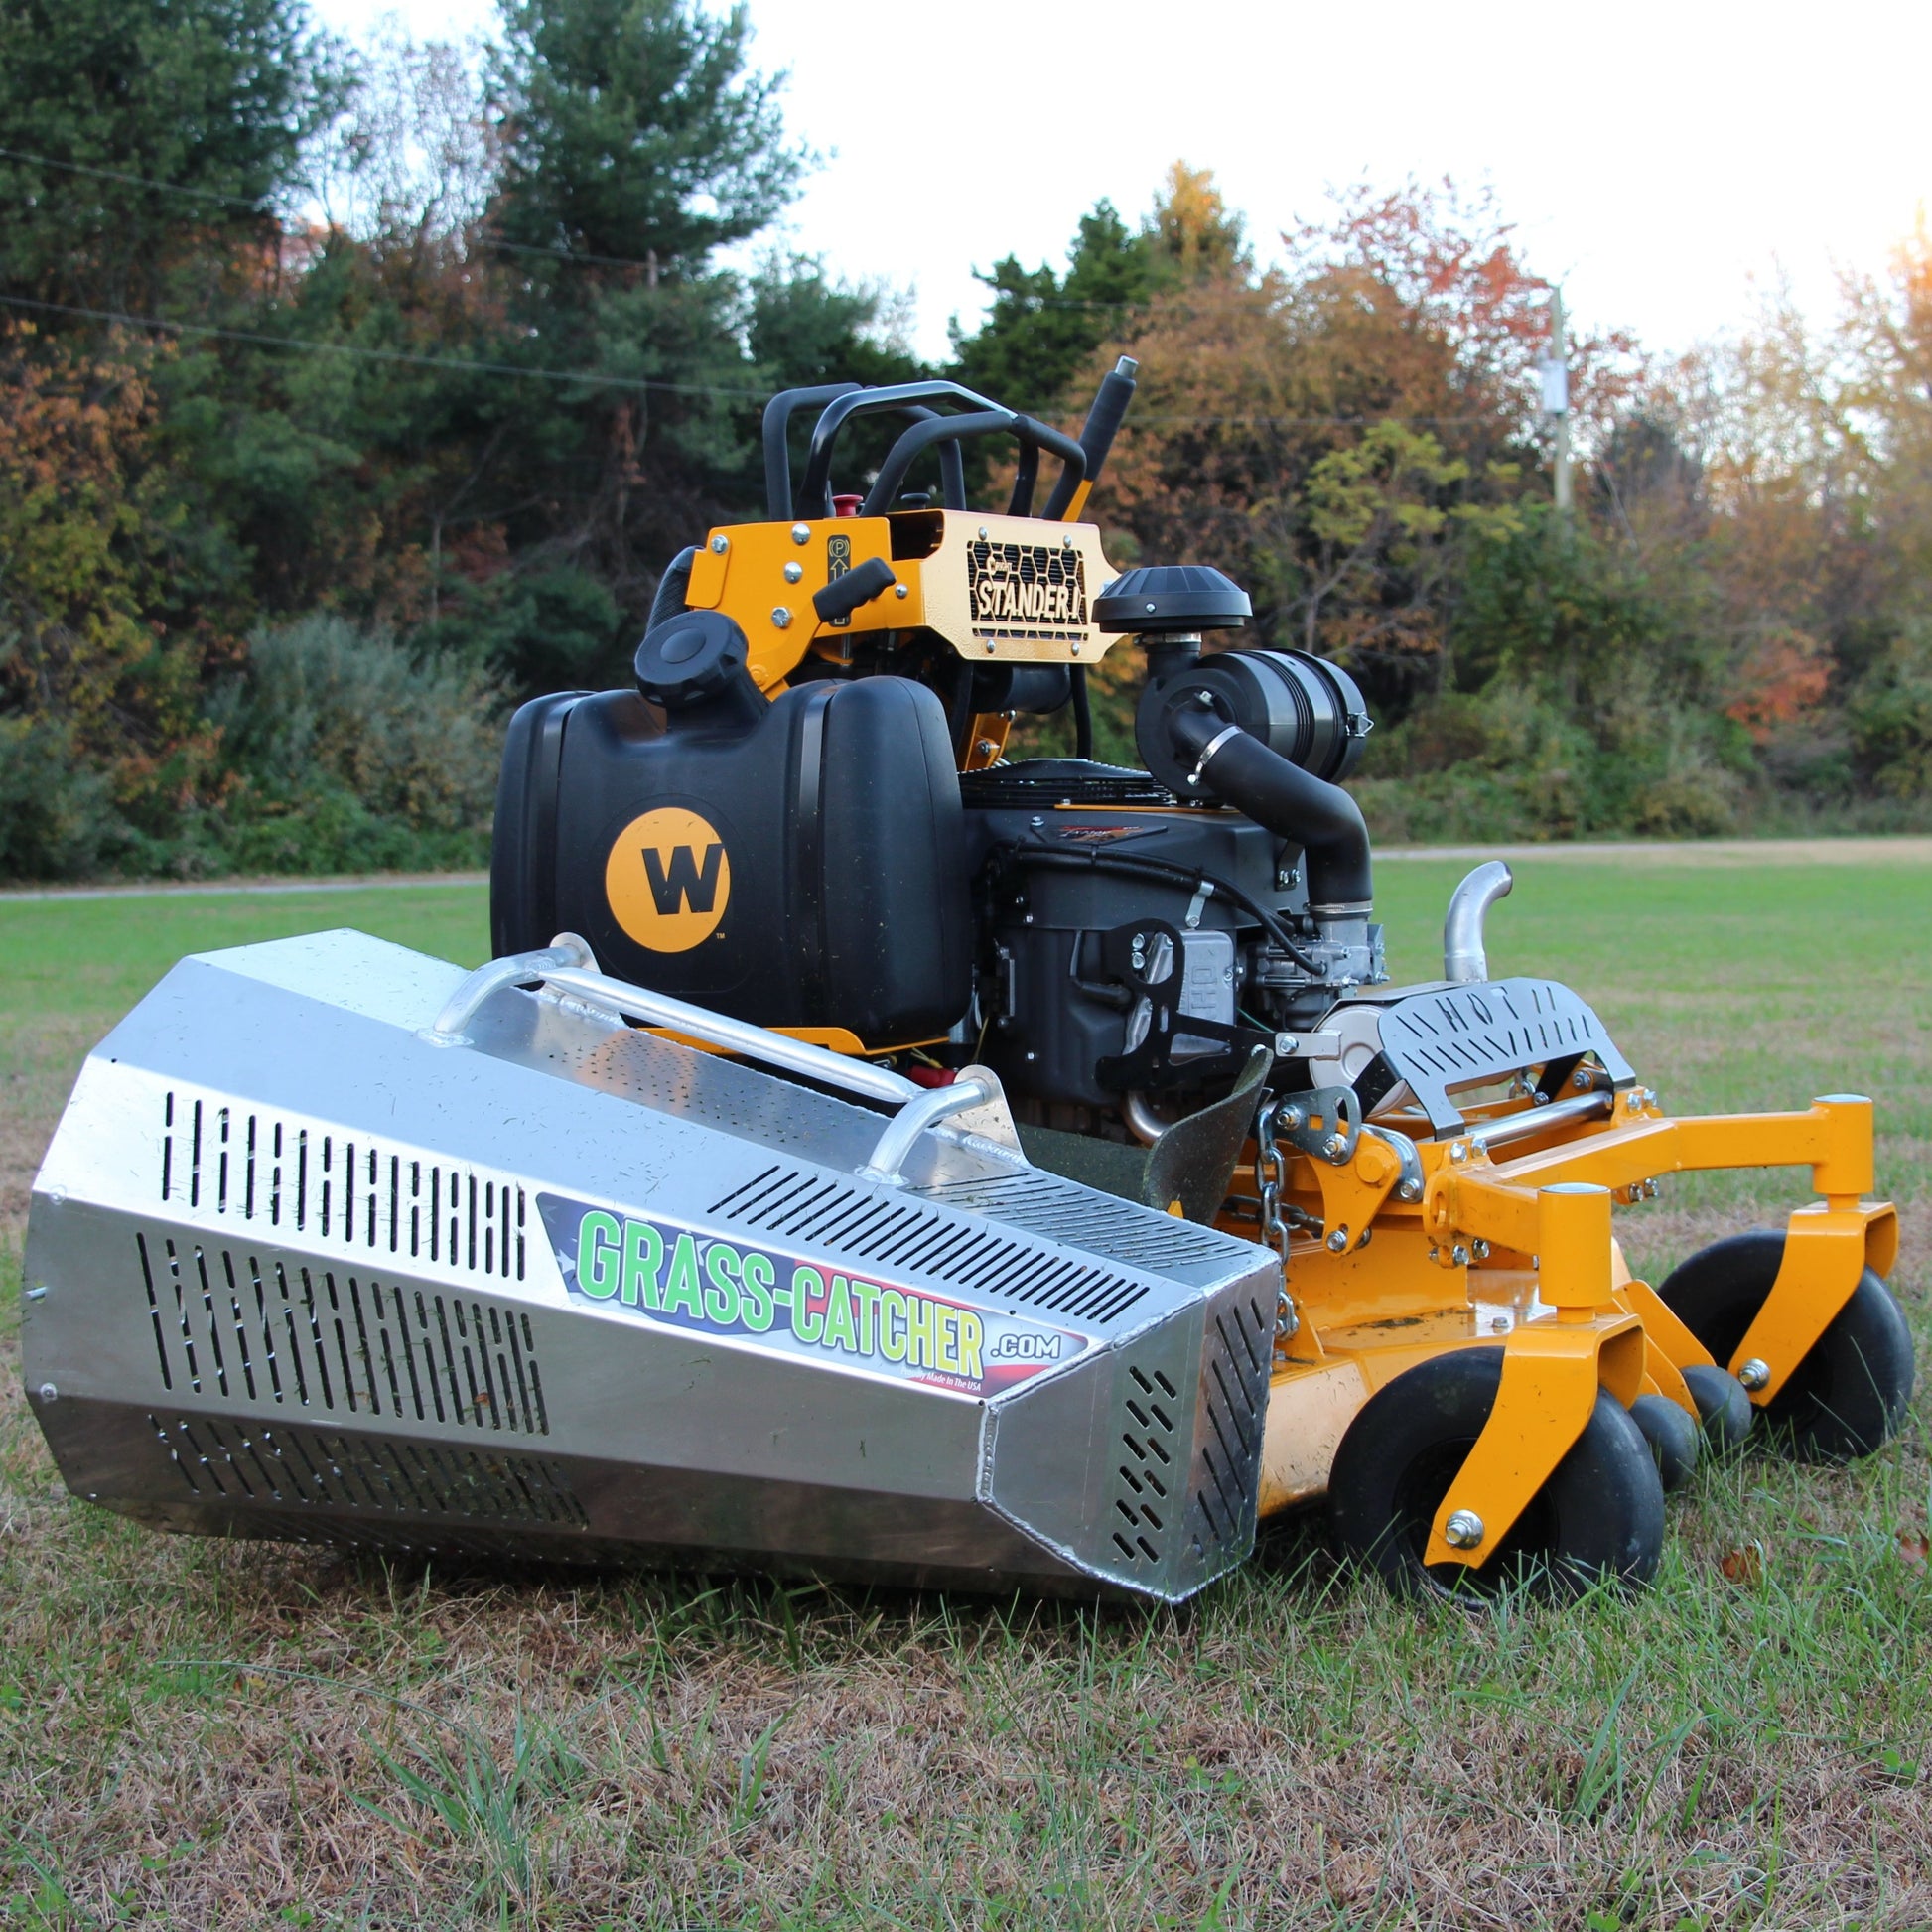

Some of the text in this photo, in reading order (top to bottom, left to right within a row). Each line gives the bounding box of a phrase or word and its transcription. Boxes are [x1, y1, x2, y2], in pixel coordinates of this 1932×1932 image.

[979, 579, 1069, 620] STANDER
[641, 843, 725, 915] W
[1435, 986, 1519, 1033] HOT
[575, 1208, 985, 1381] GRASS-CATCHER
[926, 1372, 946, 1384] Made
[946, 1376, 954, 1386] In
[954, 1377, 967, 1388] The
[967, 1381, 981, 1392] USA
